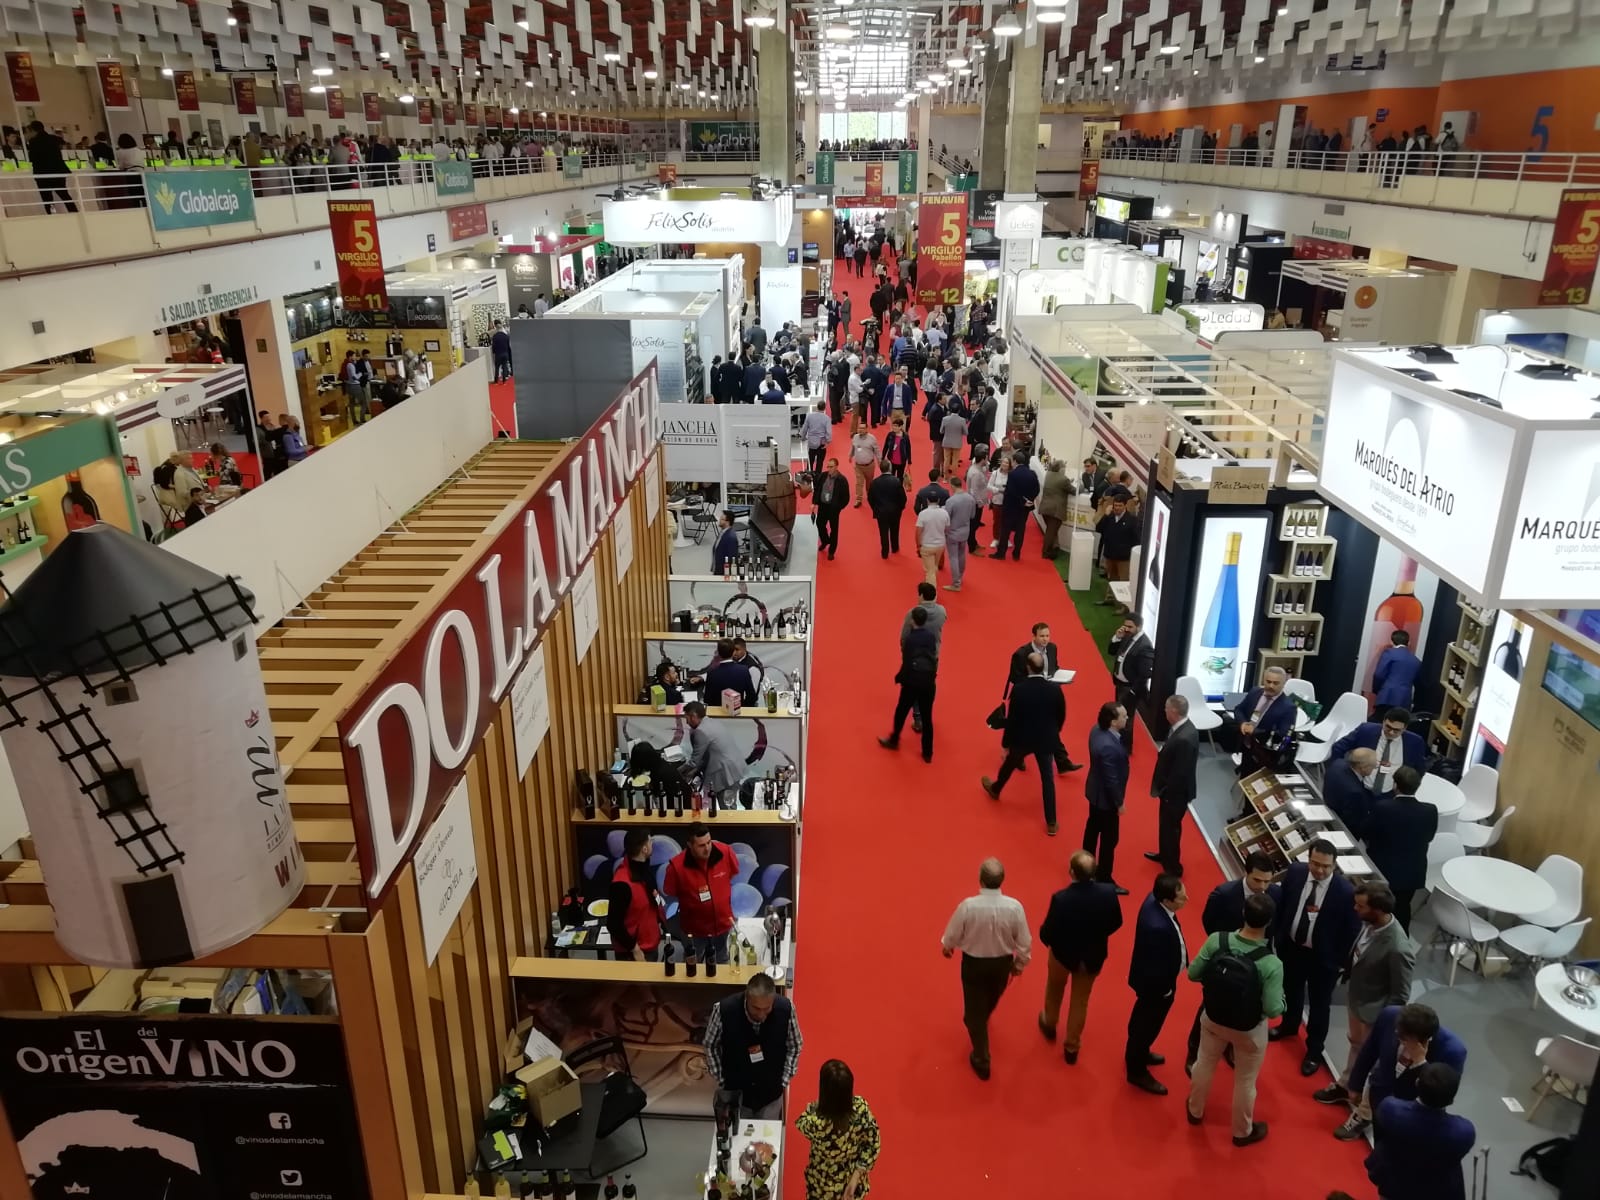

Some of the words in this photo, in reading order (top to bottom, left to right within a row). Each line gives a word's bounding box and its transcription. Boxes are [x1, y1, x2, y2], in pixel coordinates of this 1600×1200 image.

[1526, 106, 1554, 162] 5
[873, 169, 881, 181] 5
[179, 188, 240, 215] Globalcaja
[330, 203, 372, 212] FENAVIN
[922, 195, 965, 205] FENAVIN
[353, 219, 374, 252] 5
[941, 212, 961, 246] 5
[337, 252, 379, 261] VIRGILIO
[920, 246, 963, 255] VIRGILIO
[169, 301, 198, 322] SALIDA
[198, 297, 209, 315] DE
[208, 287, 253, 313] EMERGENCIA
[364, 293, 383, 304] 11
[940, 287, 960, 304] 12
[1566, 287, 1586, 304] 13
[1354, 438, 1400, 486] MARQUÉS
[1400, 467, 1418, 497] DEL
[1418, 474, 1456, 516] ATRIO
[345, 609, 481, 899] DO
[475, 509, 555, 702] LA
[547, 366, 663, 595] MANCHA
[74, 1029, 106, 1051] El
[137, 1027, 158, 1038] del
[16, 1046, 152, 1081] Origen
[140, 1038, 297, 1079] VINO
[235, 1135, 325, 1145] @vinosdelamancha
